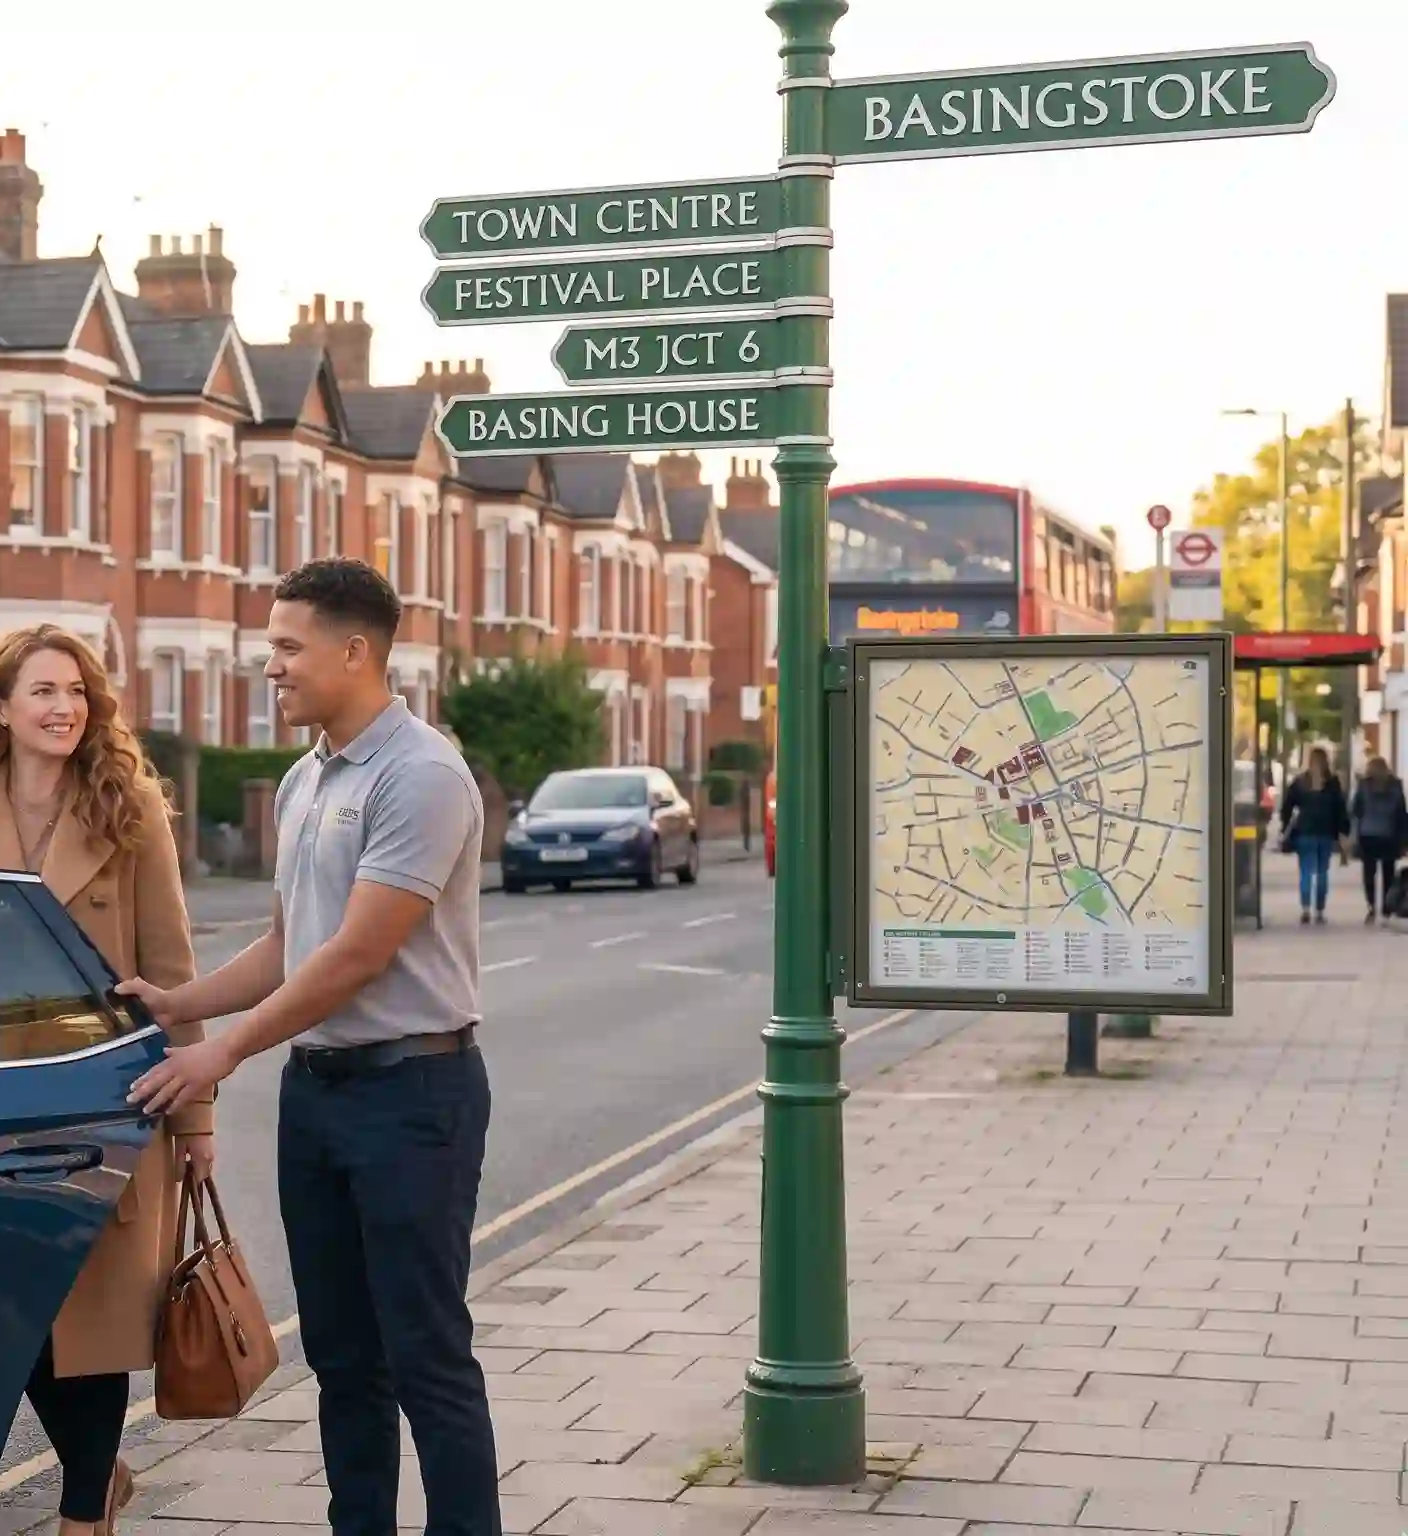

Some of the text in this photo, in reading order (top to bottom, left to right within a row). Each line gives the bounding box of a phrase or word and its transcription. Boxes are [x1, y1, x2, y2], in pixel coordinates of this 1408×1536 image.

[865, 67, 1272, 140] BASINGSTOKE
[452, 191, 758, 244] TOWN CENTRE
[454, 262, 761, 310] FESTIVAL PLACE
[583, 330, 760, 374] M3 JCT 6
[468, 398, 760, 442] BASING HOUSE
